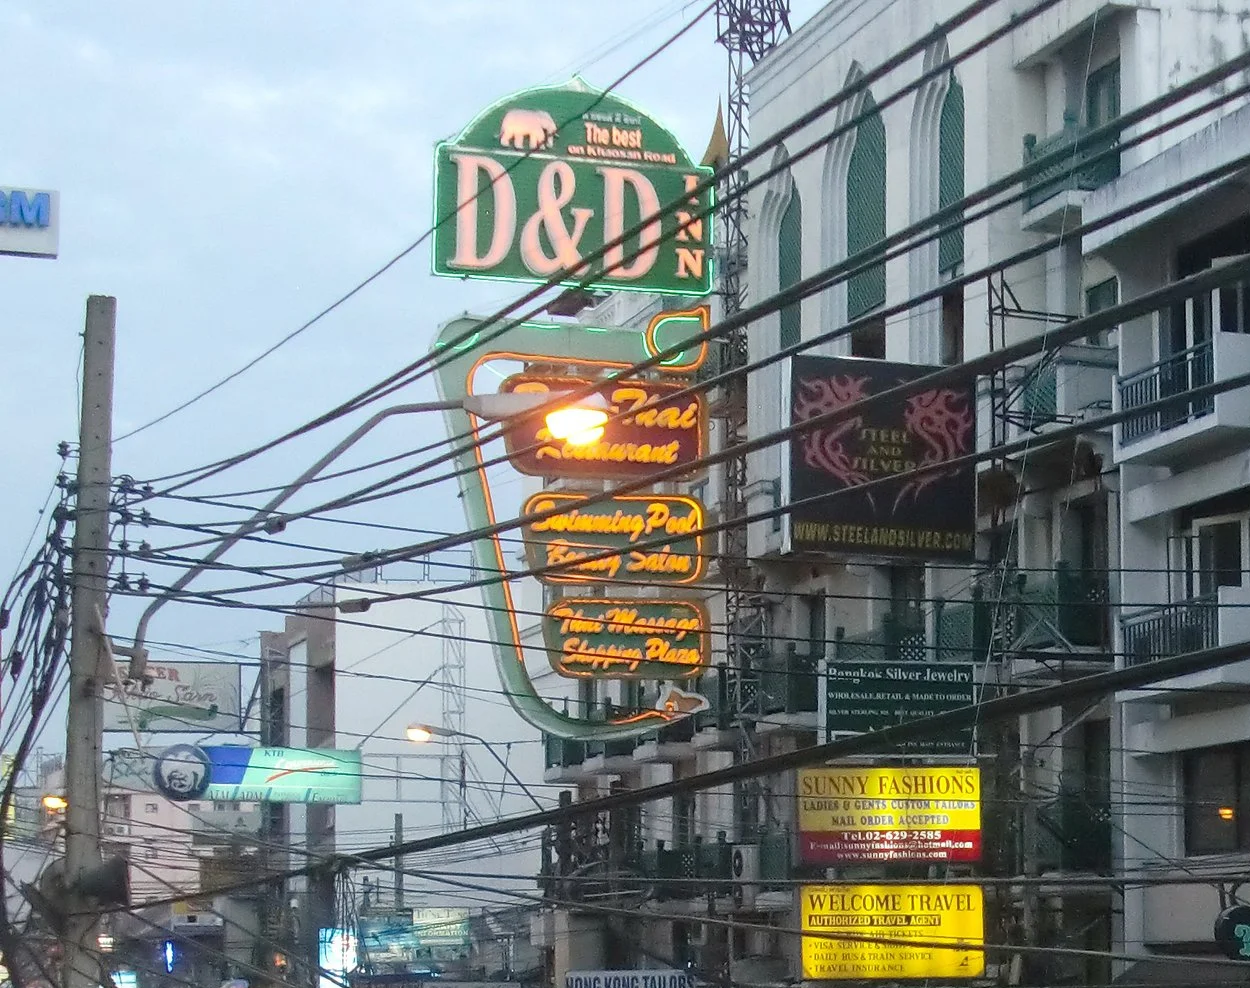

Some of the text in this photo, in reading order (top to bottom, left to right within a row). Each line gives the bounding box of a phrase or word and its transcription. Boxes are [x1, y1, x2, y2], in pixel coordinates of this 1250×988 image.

[585, 121, 642, 149] The best
[446, 153, 662, 281] D&D
[645, 503, 698, 535] Pool
[561, 637, 701, 671] Shopping Plaza
[886, 668, 922, 680] Silver
[924, 668, 971, 683] Jewelry
[803, 775, 976, 796] SUNNY FASHIONS
[803, 800, 839, 811] LADIES
[854, 800, 887, 811] GENTS
[891, 800, 930, 810] CUSTOM
[934, 799, 976, 810] TAILORS
[831, 814, 949, 826] MAIL ORDER ACCEPTED
[837, 850, 948, 860] www.sunnyfashions.com
[809, 893, 976, 912] WELCOME TRAVEL
[810, 915, 941, 926] AUTHORIZED TRAVEL AGENT
[814, 942, 834, 950] VISA
[814, 953, 838, 961] DAILY
[841, 953, 859, 961] BUS
[868, 952, 896, 961] TRAIN
[899, 952, 934, 961] SERVICE
[814, 965, 905, 973] TRAVEL INSURANCE
